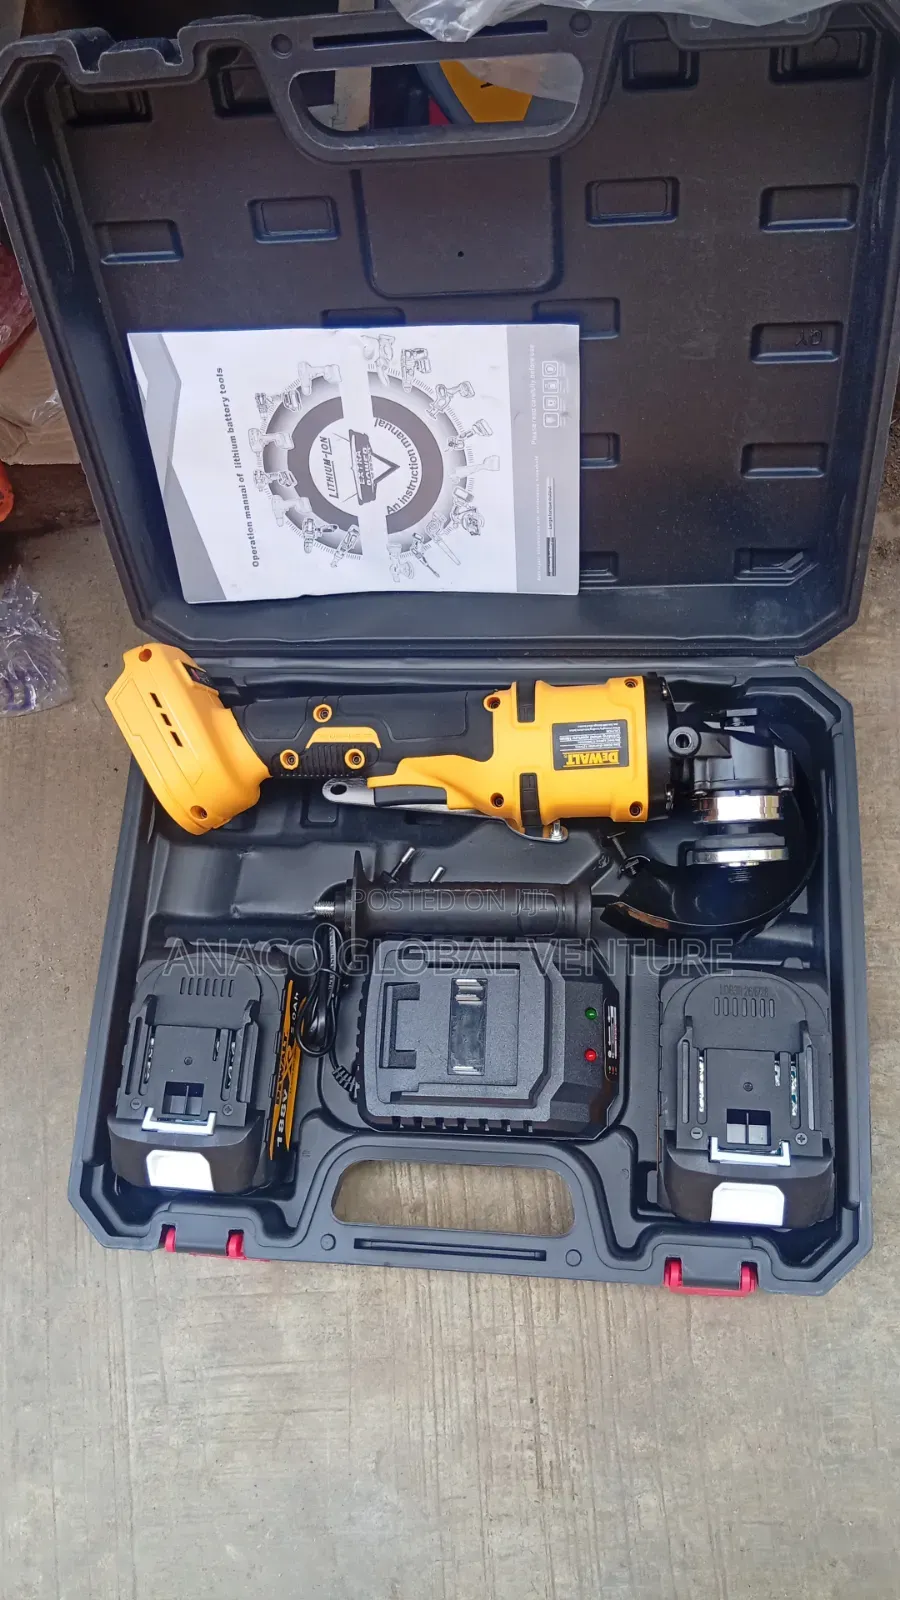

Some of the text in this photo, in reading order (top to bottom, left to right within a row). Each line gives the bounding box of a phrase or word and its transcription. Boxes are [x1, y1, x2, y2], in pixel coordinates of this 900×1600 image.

[528, 358, 536, 379] before
[529, 380, 537, 407] carefully
[216, 367, 260, 568] Operation manual of lithium battery tools
[319, 436, 340, 499] LITHIUM-ION
[355, 450, 366, 485] EXTRA
[373, 417, 419, 516] An instruction manual
